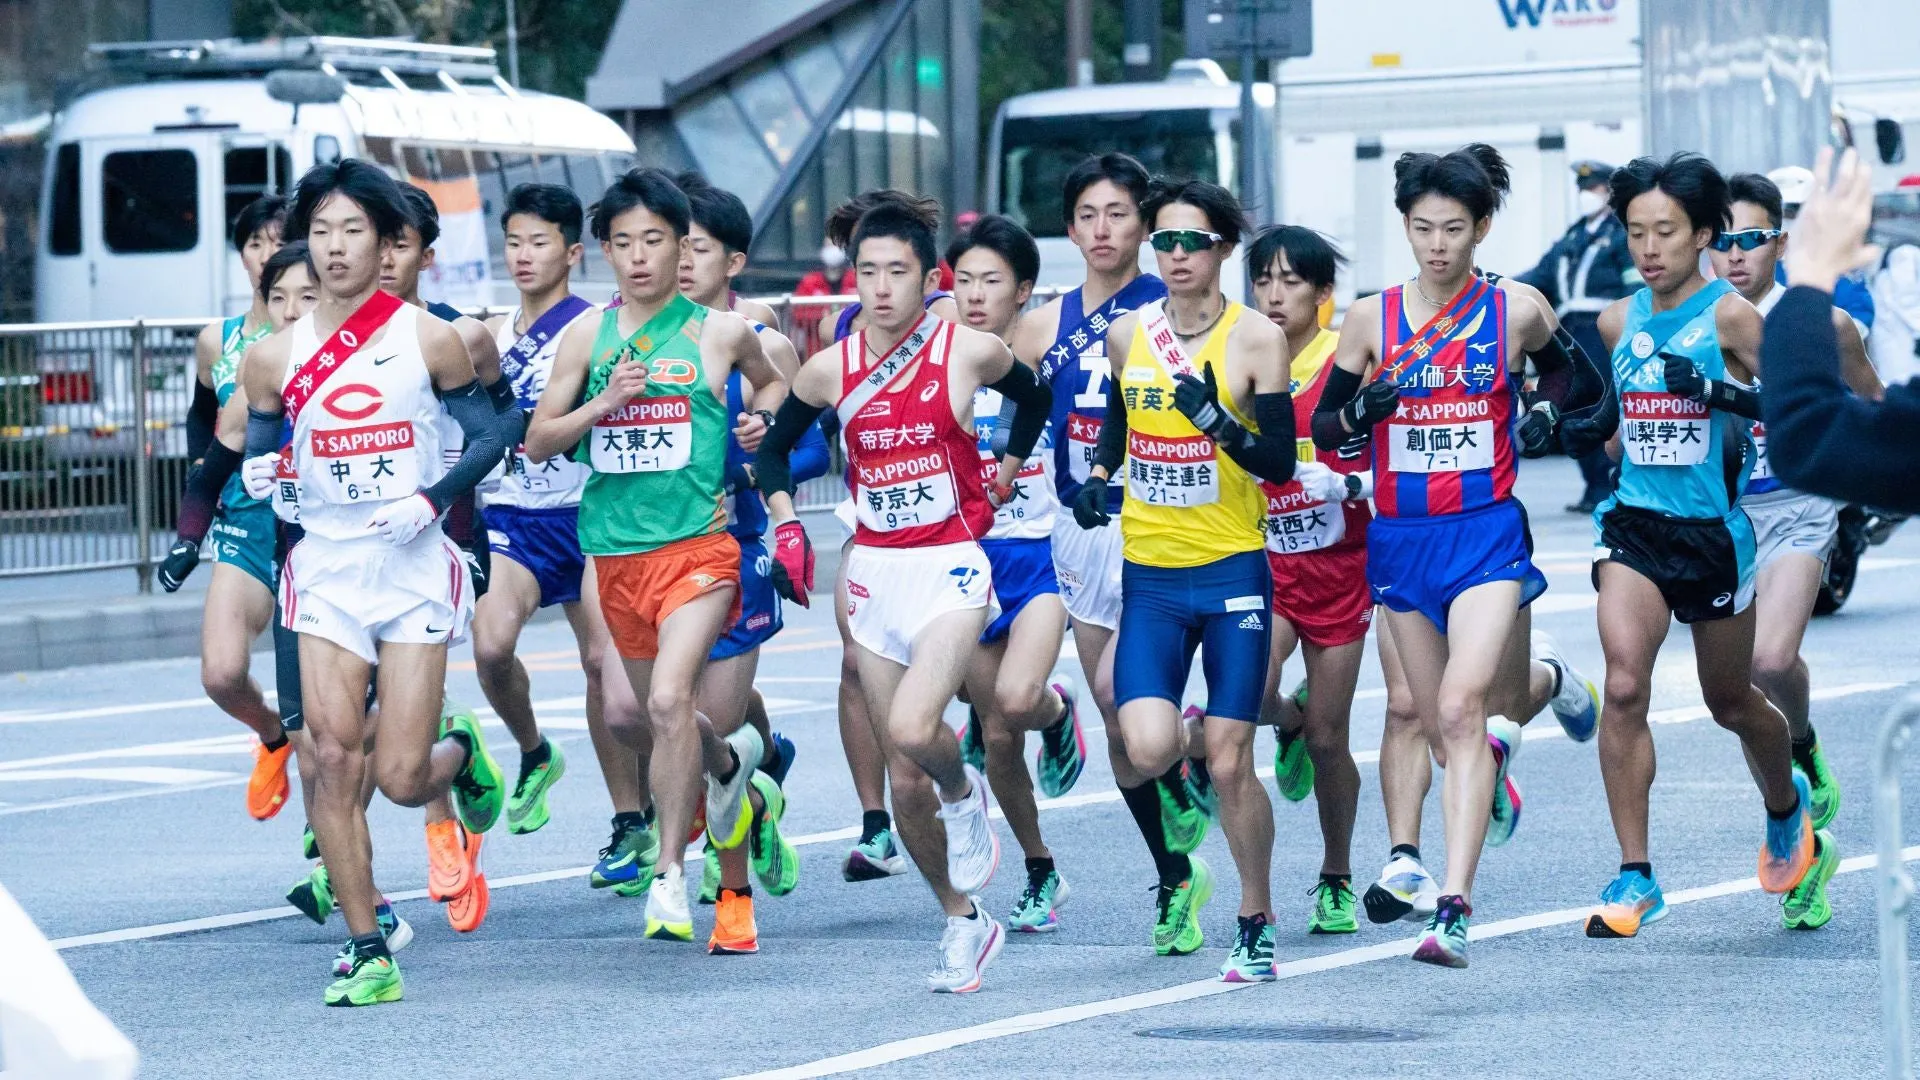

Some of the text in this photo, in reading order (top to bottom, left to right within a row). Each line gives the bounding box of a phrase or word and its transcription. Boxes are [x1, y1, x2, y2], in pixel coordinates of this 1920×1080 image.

[606, 402, 686, 422] SAPPORO
[1412, 399, 1488, 420] SAPPORO
[1636, 398, 1707, 414] SAPPORO
[328, 427, 410, 453] SAPPORO
[602, 426, 674, 452] 大東大
[858, 422, 936, 450] 帝京大学
[1406, 425, 1477, 451] 創価大
[1627, 420, 1702, 444] 山梨学大
[1139, 440, 1212, 458] SAPPORO
[1640, 446, 1677, 463] 17-1
[617, 452, 659, 470] 11-1
[864, 453, 942, 484] SAPPORO
[1424, 453, 1458, 470] 7-1
[1130, 457, 1212, 487] 関東学生連合
[348, 484, 382, 500] 6-1
[867, 482, 934, 513] 帝京大
[1147, 486, 1187, 504] 21-1
[886, 512, 920, 528] 9-1
[1279, 536, 1320, 552] 13-1
[1239, 622, 1264, 630] adidas
